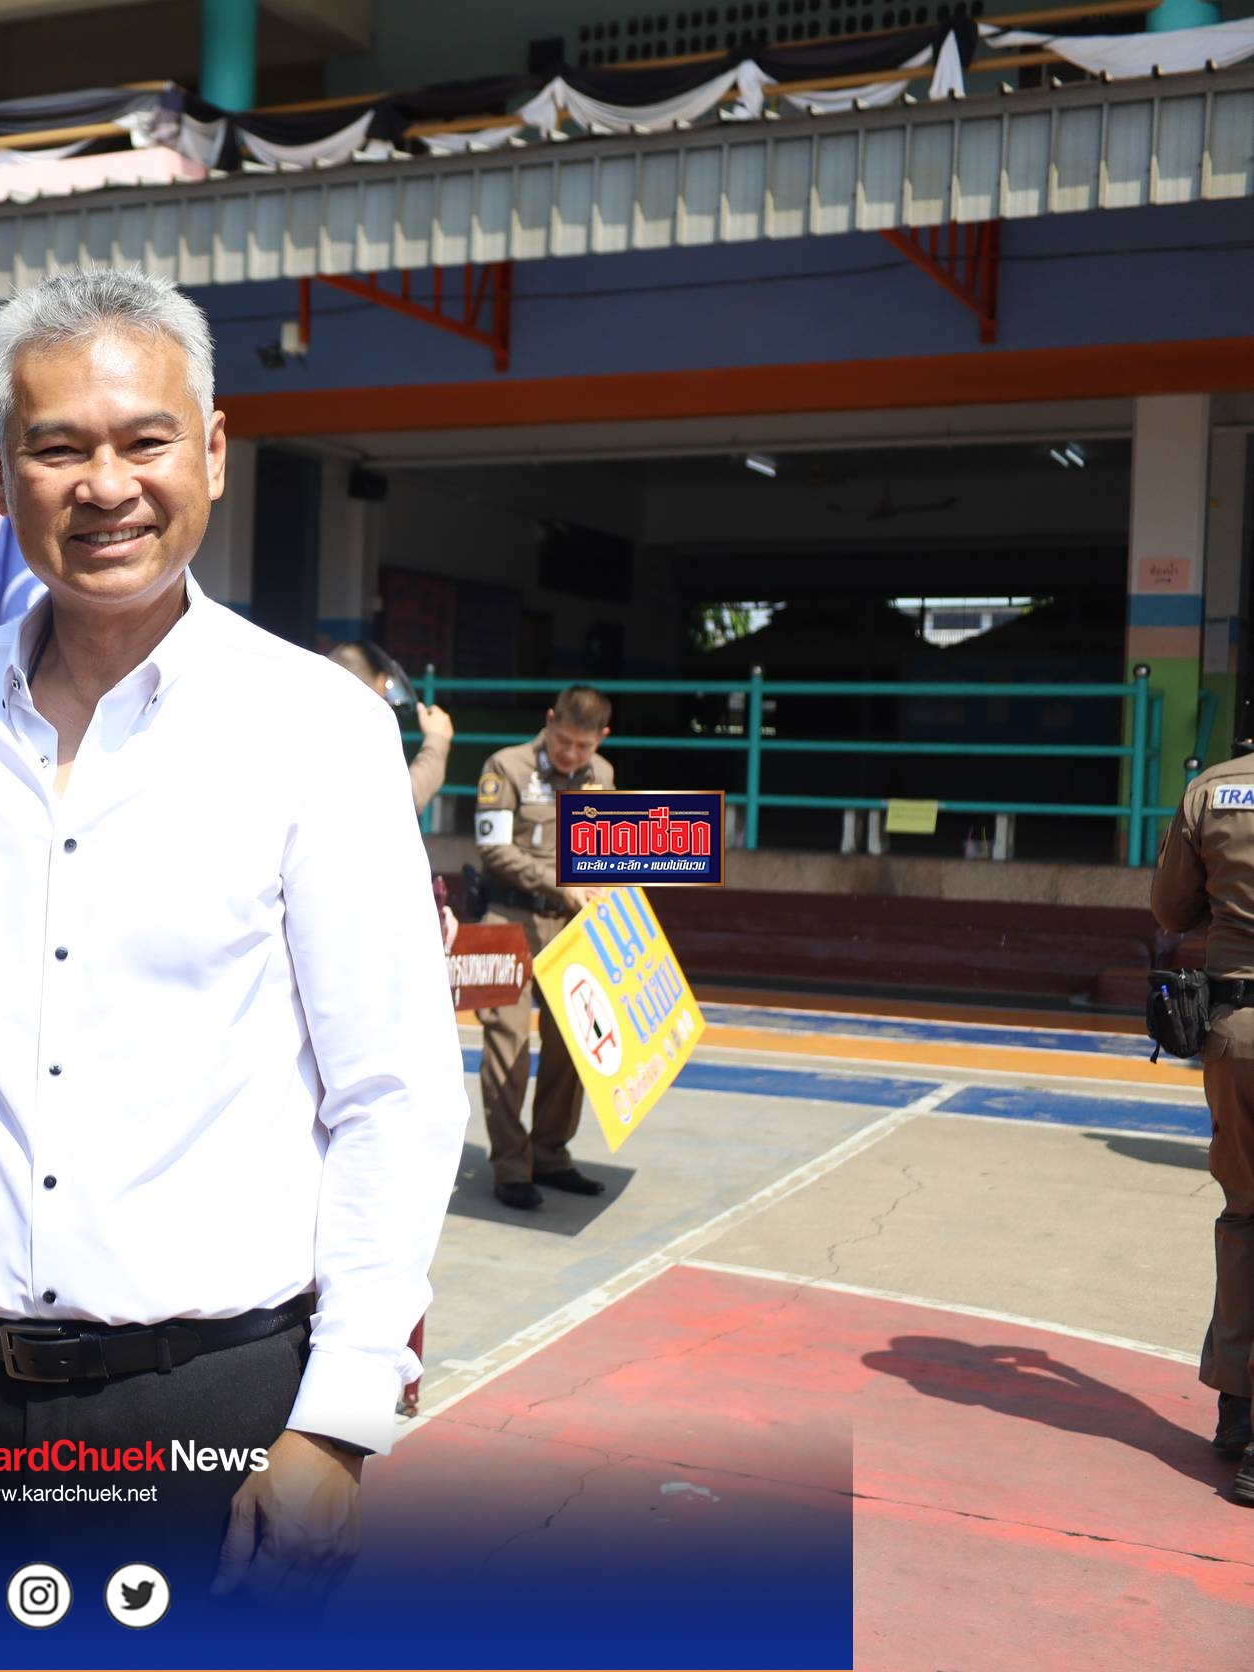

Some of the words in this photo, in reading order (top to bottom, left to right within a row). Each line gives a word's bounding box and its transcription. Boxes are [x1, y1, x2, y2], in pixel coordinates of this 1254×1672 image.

[583, 886, 656, 984] เมา
[621, 955, 683, 1044] ไม่ขับ
